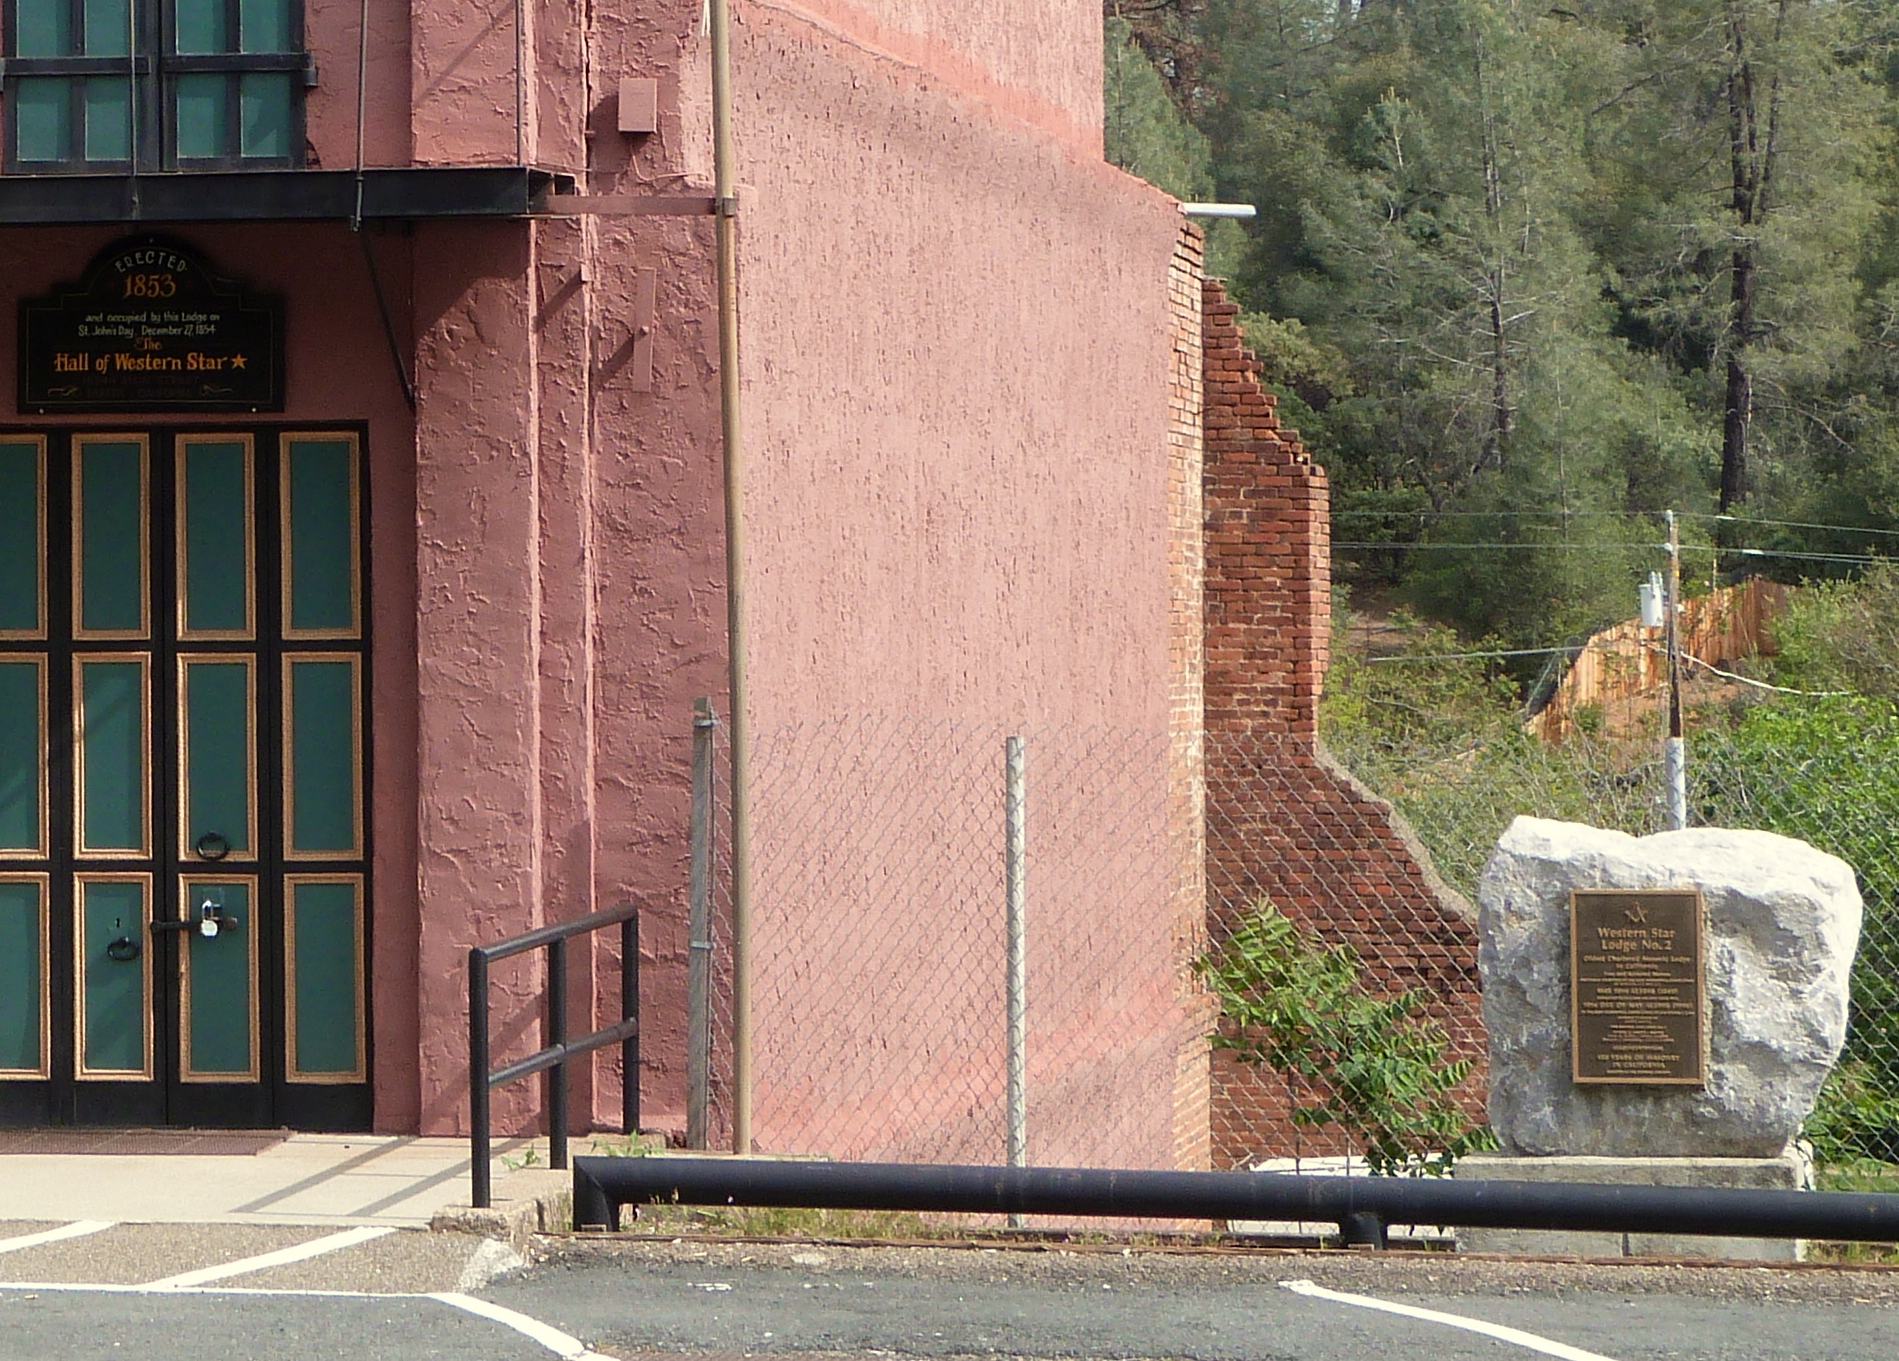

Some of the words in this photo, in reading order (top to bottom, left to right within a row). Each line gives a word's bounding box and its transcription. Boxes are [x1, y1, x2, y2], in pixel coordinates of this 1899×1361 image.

[114, 251, 187, 274] ERECTED
[123, 274, 177, 298] 1853
[85, 312, 103, 323] and
[107, 311, 147, 325] occupied
[151, 312, 162, 326] by
[164, 311, 179, 322] this
[182, 312, 207, 324] Lodge
[141, 324, 183, 337] December
[54, 353, 89, 372] Hall
[95, 354, 111, 375] of
[115, 352, 182, 371] Western
[187, 352, 228, 371] Star
[1598, 927, 1647, 939] Western
[1651, 927, 1676, 939] Star
[1602, 939, 1637, 953] Lodge
